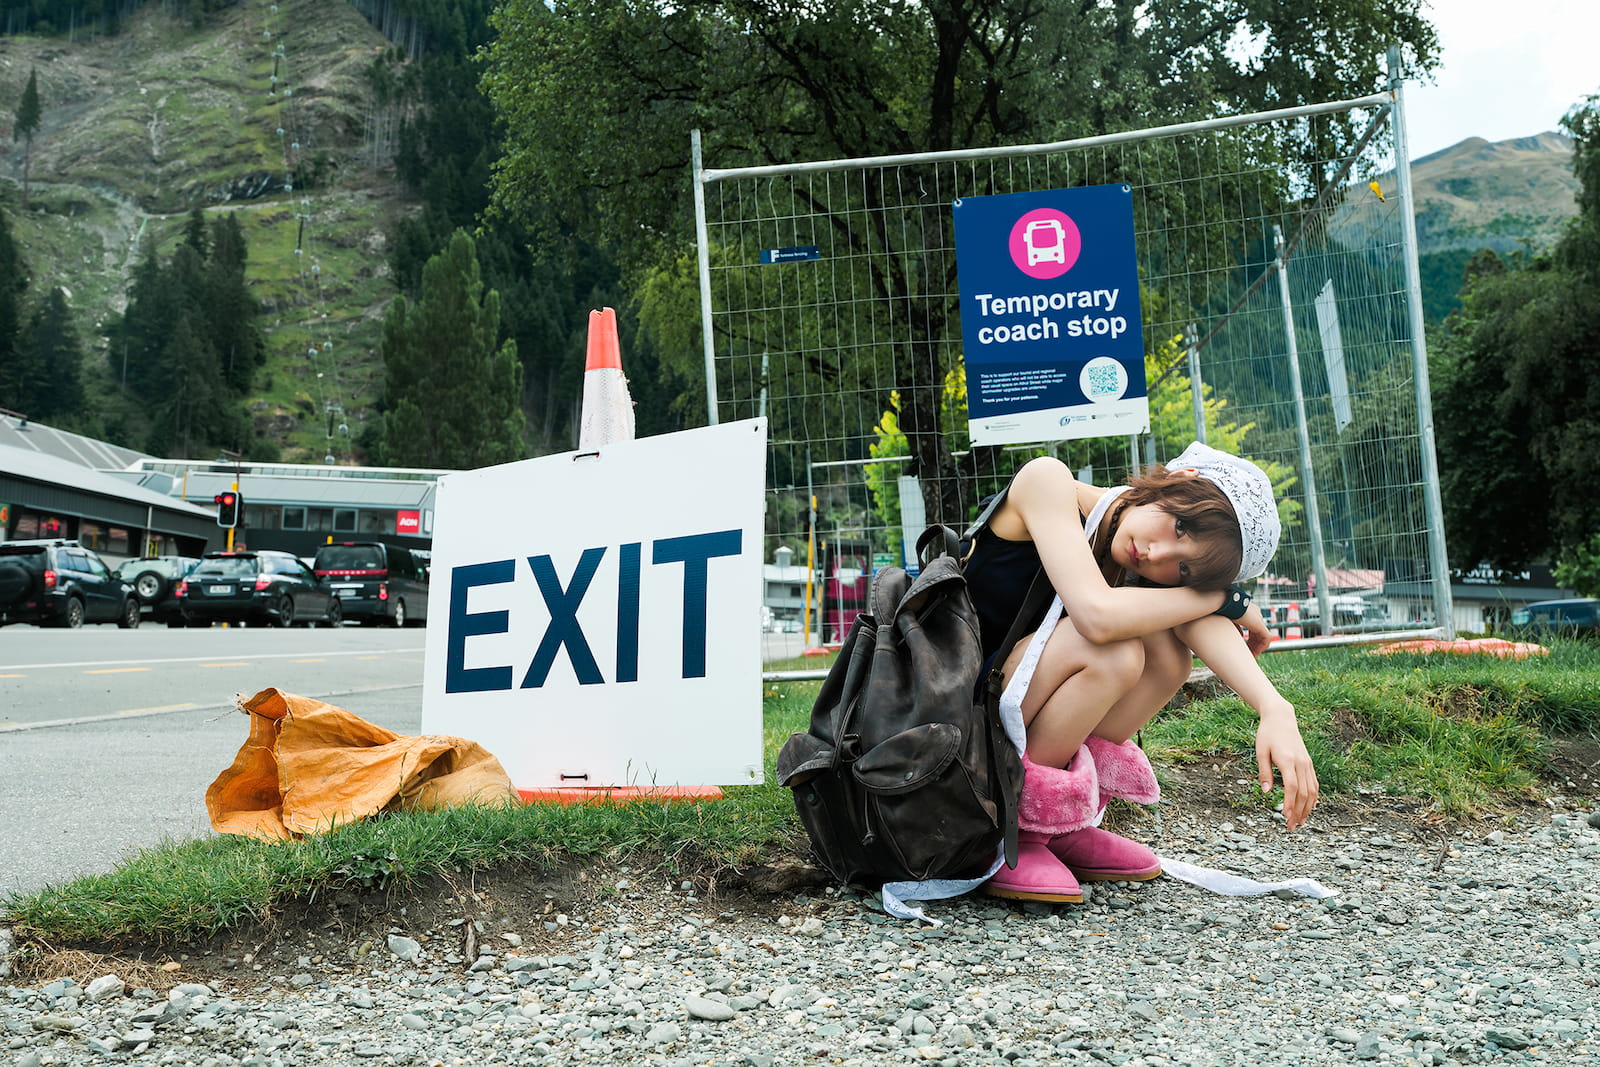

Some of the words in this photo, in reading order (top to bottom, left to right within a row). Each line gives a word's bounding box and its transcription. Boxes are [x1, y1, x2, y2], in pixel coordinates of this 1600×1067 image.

[975, 288, 1119, 317] Temporary
[978, 317, 1059, 344] coach
[1067, 314, 1127, 339] stop
[446, 528, 742, 694] EXIT
